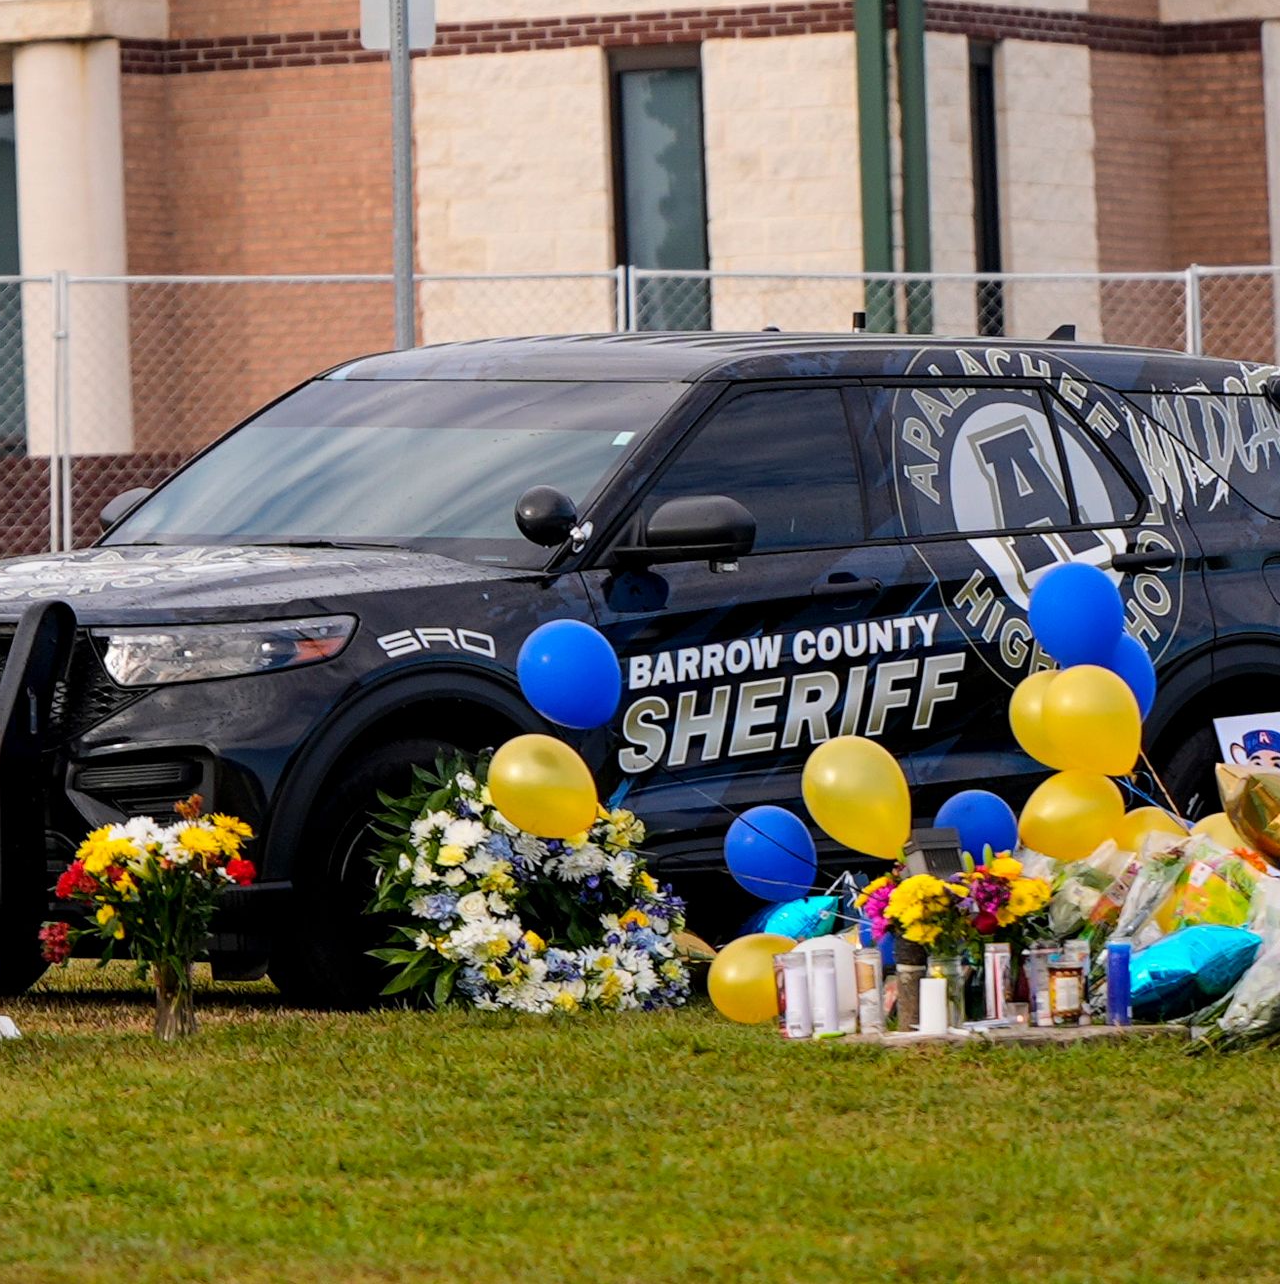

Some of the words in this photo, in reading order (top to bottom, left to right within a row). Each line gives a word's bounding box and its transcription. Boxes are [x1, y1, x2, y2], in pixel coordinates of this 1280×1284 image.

[901, 348, 1119, 504] APALACHEE
[1122, 494, 1177, 651] HOOL
[376, 627, 497, 659] SRO
[628, 634, 783, 690] BARROW
[791, 612, 940, 665] COUNTY
[617, 651, 967, 775] SHERIFF
